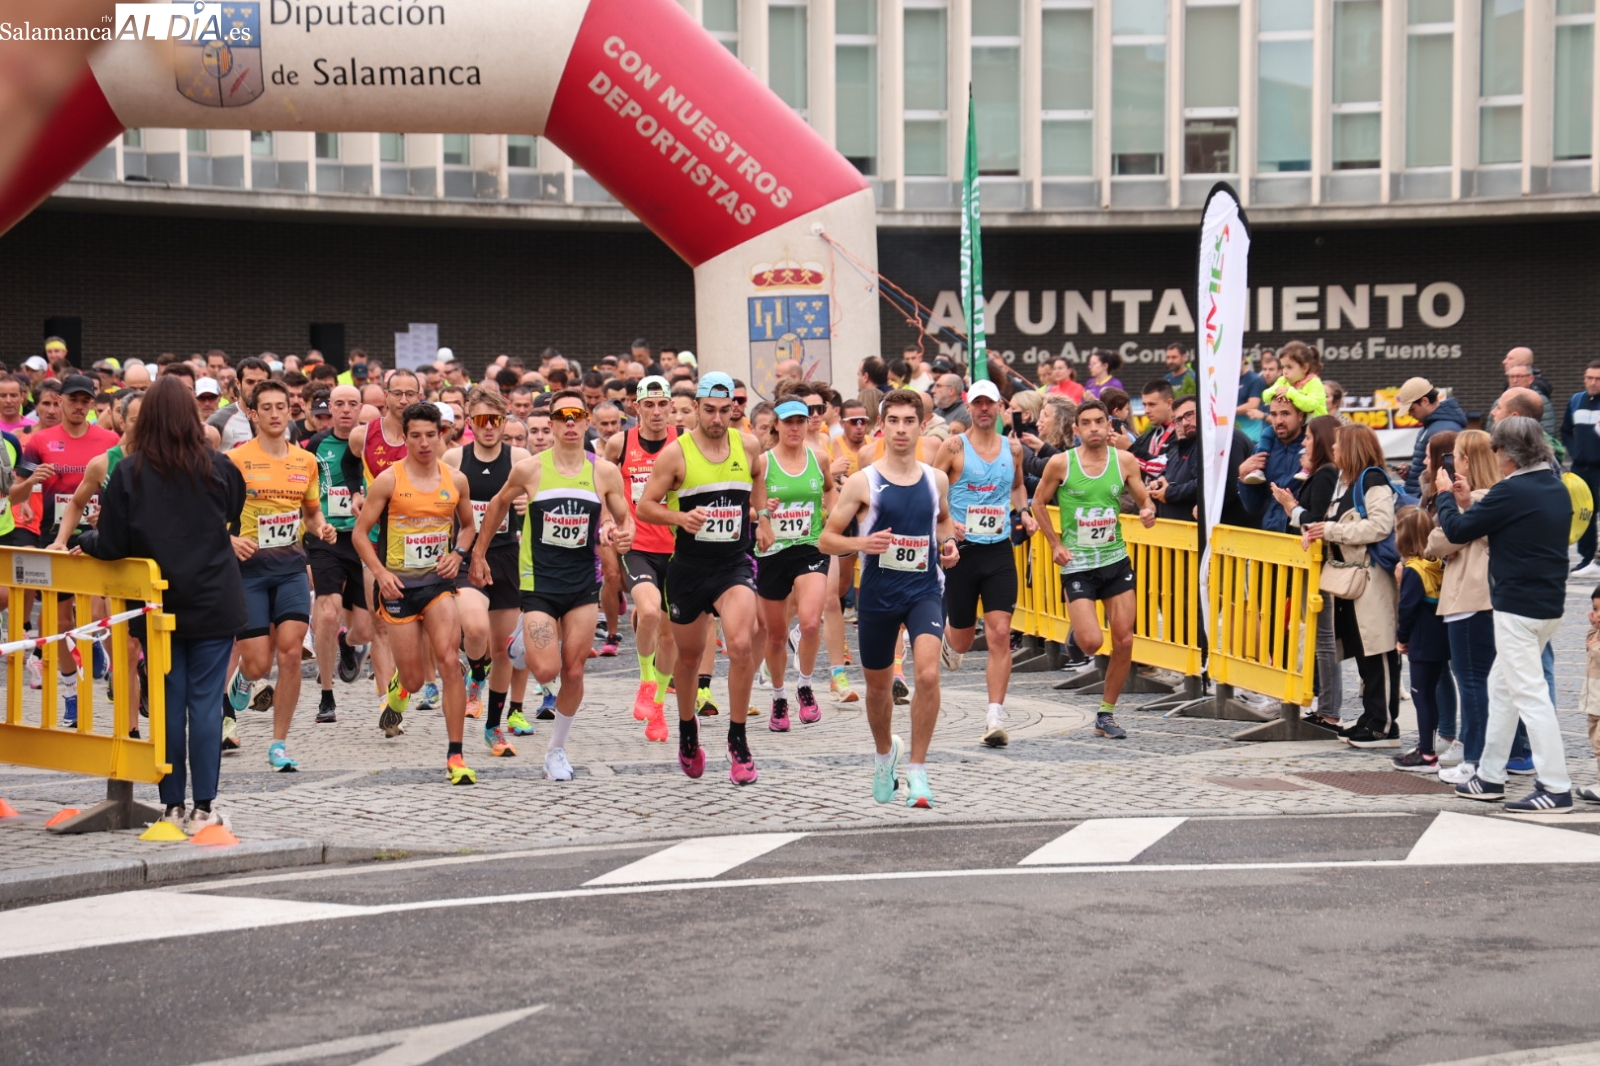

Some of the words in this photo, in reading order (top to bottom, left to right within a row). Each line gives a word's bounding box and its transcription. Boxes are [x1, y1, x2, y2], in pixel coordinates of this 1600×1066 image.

[270, 0, 446, 32] Diputación
[271, 64, 300, 86] de
[313, 58, 482, 86] Salamanca
[602, 35, 662, 92] CON
[657, 85, 794, 209] NUESTROS
[587, 70, 758, 226] DEPORTISTAS
[925, 281, 1466, 334] AYUNTAIENTO
[1022, 346, 1051, 364] de
[1316, 337, 1363, 360] José
[1367, 336, 1462, 360] Fuentes
[544, 513, 589, 526] bedunia
[1074, 507, 1116, 519] LEA
[705, 519, 734, 533] 210
[780, 518, 803, 532] 219
[979, 515, 996, 528] 48
[1078, 518, 1117, 527] bedunia
[268, 523, 295, 538] 147
[552, 525, 580, 539] 209
[1091, 527, 1107, 540] 27
[406, 533, 447, 545] bedunia
[415, 544, 439, 559] 134
[895, 547, 916, 562] 80
